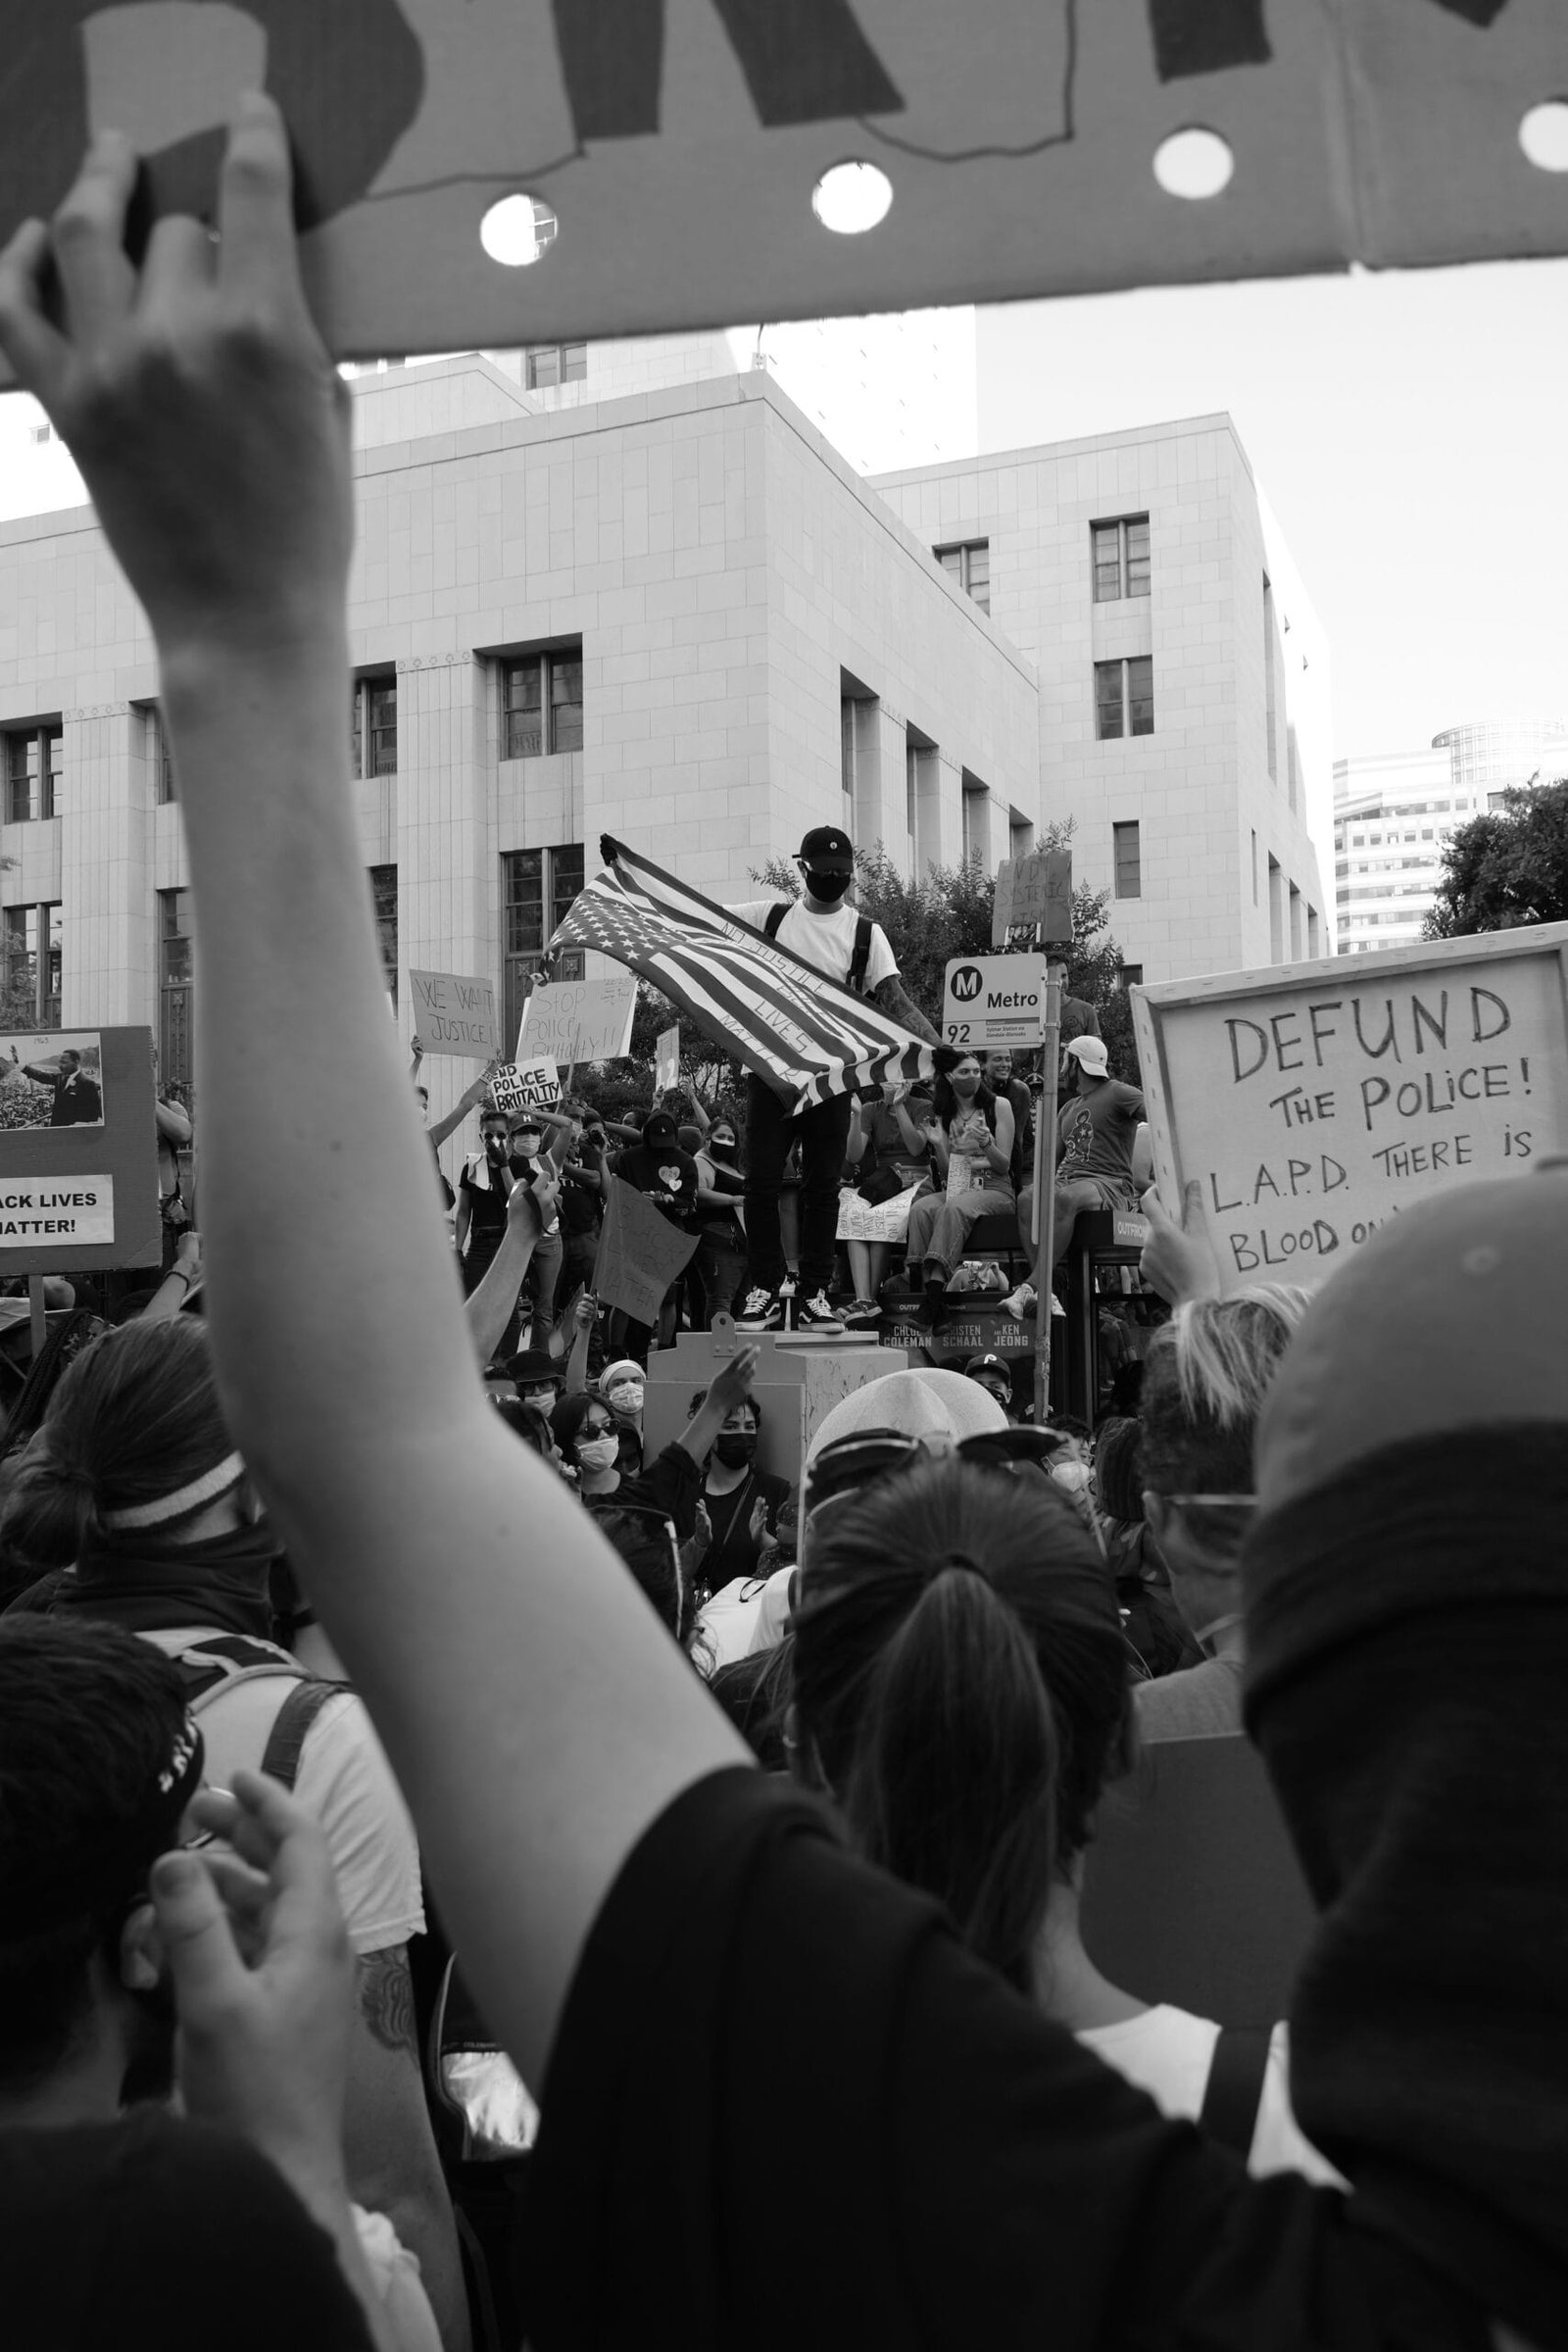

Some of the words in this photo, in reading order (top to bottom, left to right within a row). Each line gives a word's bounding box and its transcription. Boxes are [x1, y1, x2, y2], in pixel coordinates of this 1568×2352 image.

[415, 979, 446, 1009] WE
[956, 972, 978, 996] M
[987, 992, 1039, 1008] Metro
[428, 1013, 494, 1048] JUSTICE!
[755, 1001, 814, 1054] LIVES
[948, 1024, 970, 1044] 92
[1223, 987, 1511, 1084] DEFUND
[493, 1068, 547, 1094] POLICE
[496, 1081, 560, 1111] BRUTALITY
[1270, 1087, 1336, 1128] THE
[1209, 1153, 1350, 1213] L.A.P.D.
[1372, 1134, 1473, 1178] THERE
[40, 1193, 96, 1207] LIVES
[1117, 1221, 1147, 1238] OUTFRON
[1229, 1219, 1340, 1273] BLOOD
[884, 1337, 932, 1348] COLEMAN
[943, 1336, 984, 1348] SCHAAL
[994, 1335, 1029, 1347] JEONG
[894, 1325, 922, 1337] CHLO
[1002, 1324, 1020, 1336] KEN
